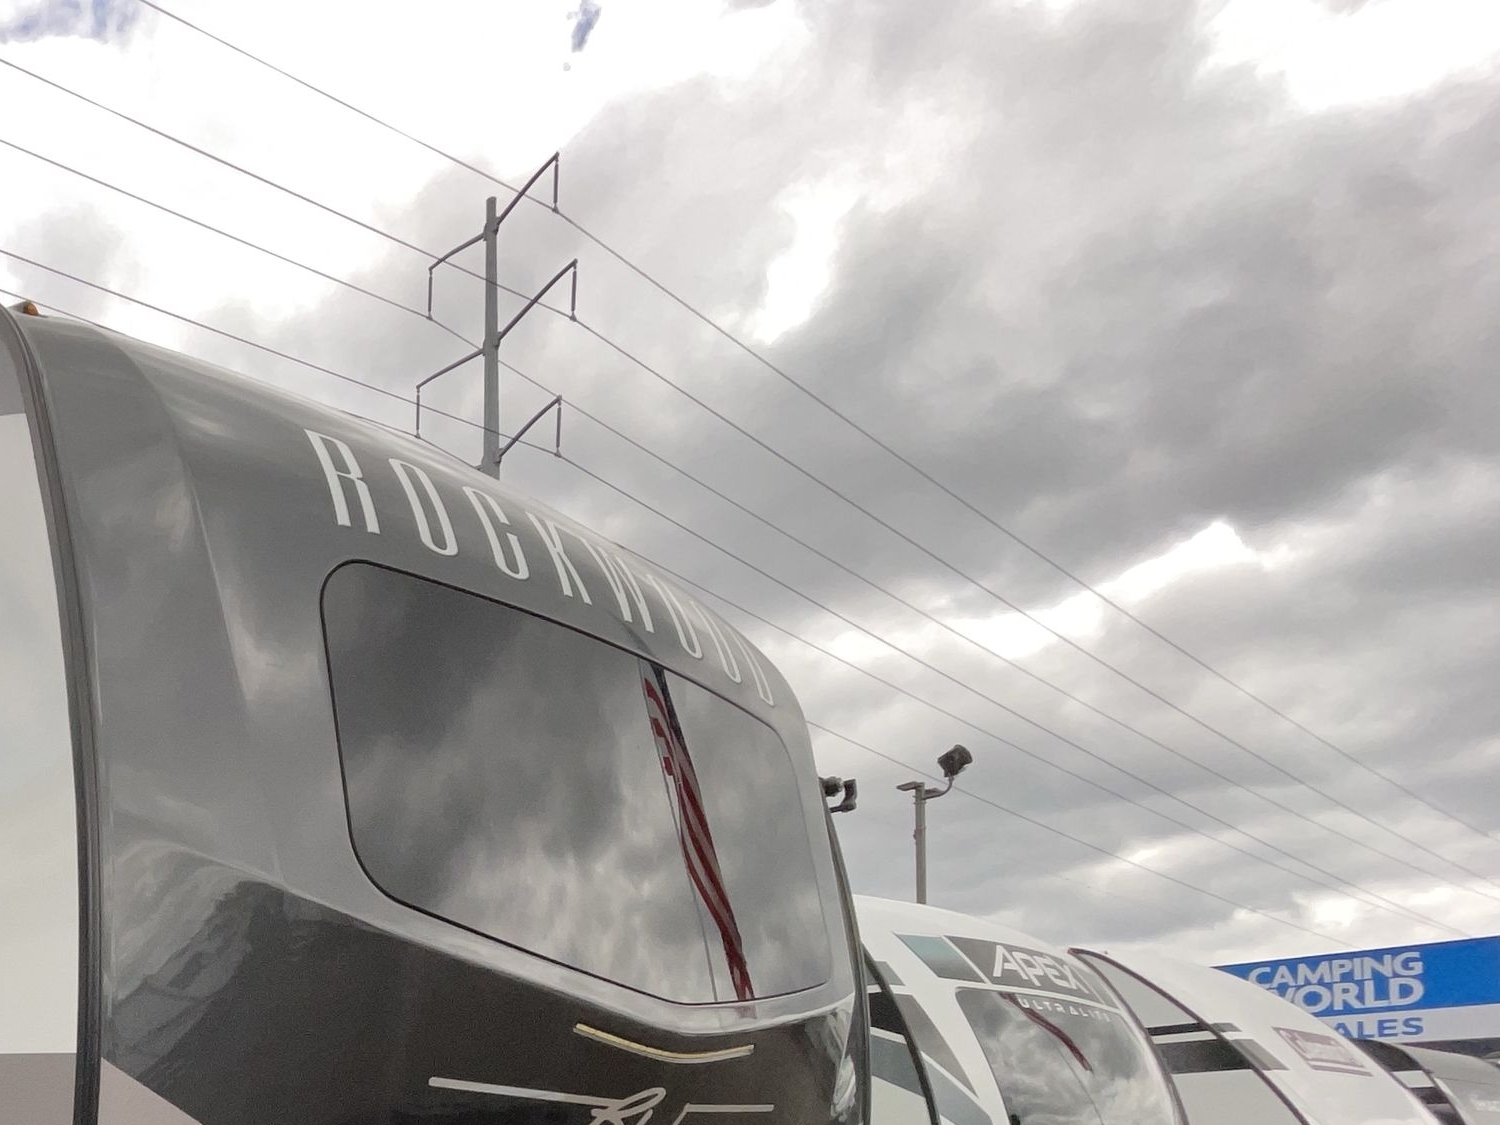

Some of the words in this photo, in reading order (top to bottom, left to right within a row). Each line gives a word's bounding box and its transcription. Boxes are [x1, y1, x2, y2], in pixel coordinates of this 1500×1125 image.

[304, 428, 774, 706] ROCKWOOD
[992, 945, 1090, 994] APEX
[1248, 951, 1424, 986] CAMPING
[1335, 1017, 1424, 1039] ALES
